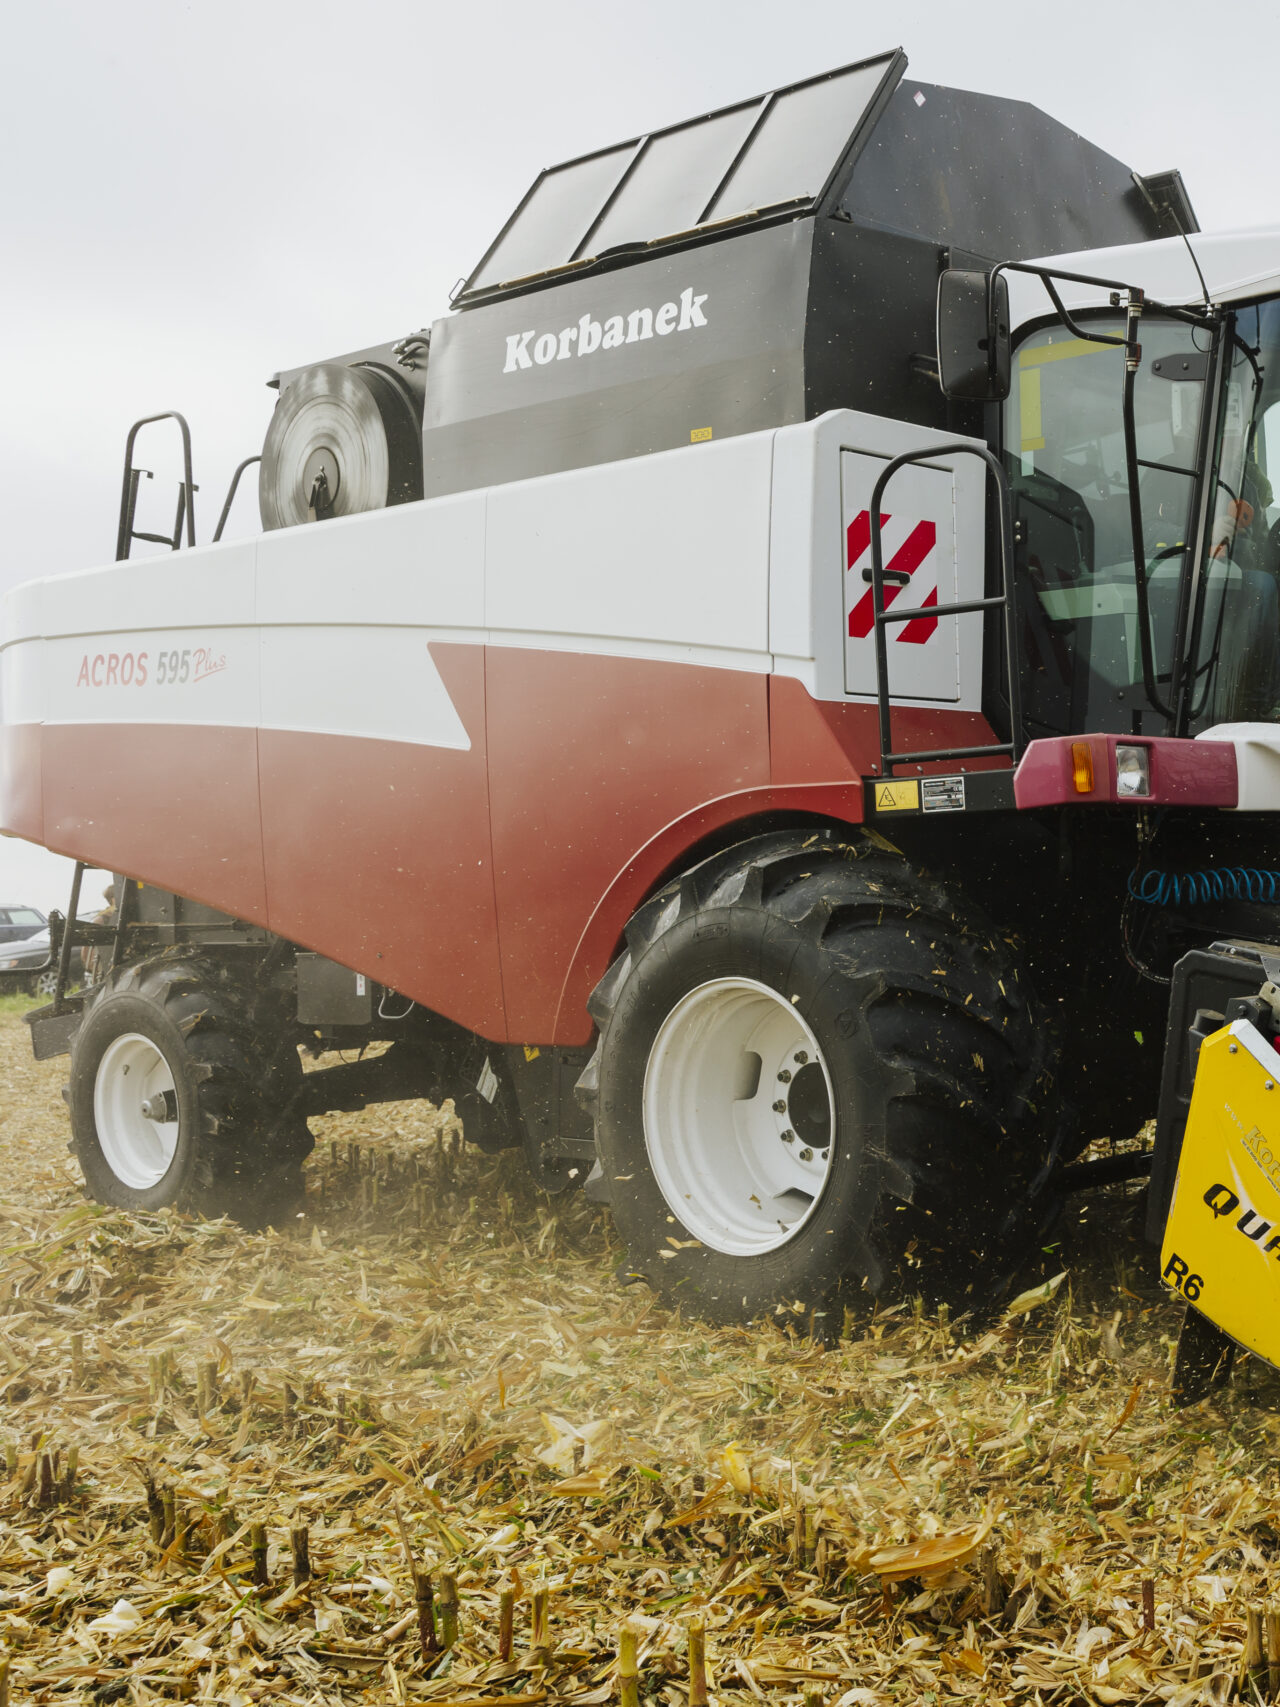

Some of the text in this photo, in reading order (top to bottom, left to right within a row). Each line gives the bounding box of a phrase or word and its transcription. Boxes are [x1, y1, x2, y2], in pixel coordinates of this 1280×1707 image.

[502, 287, 709, 374] Korbanek
[76, 648, 227, 688] ACROS 595 Plus
[1163, 1252, 1205, 1302] R6
